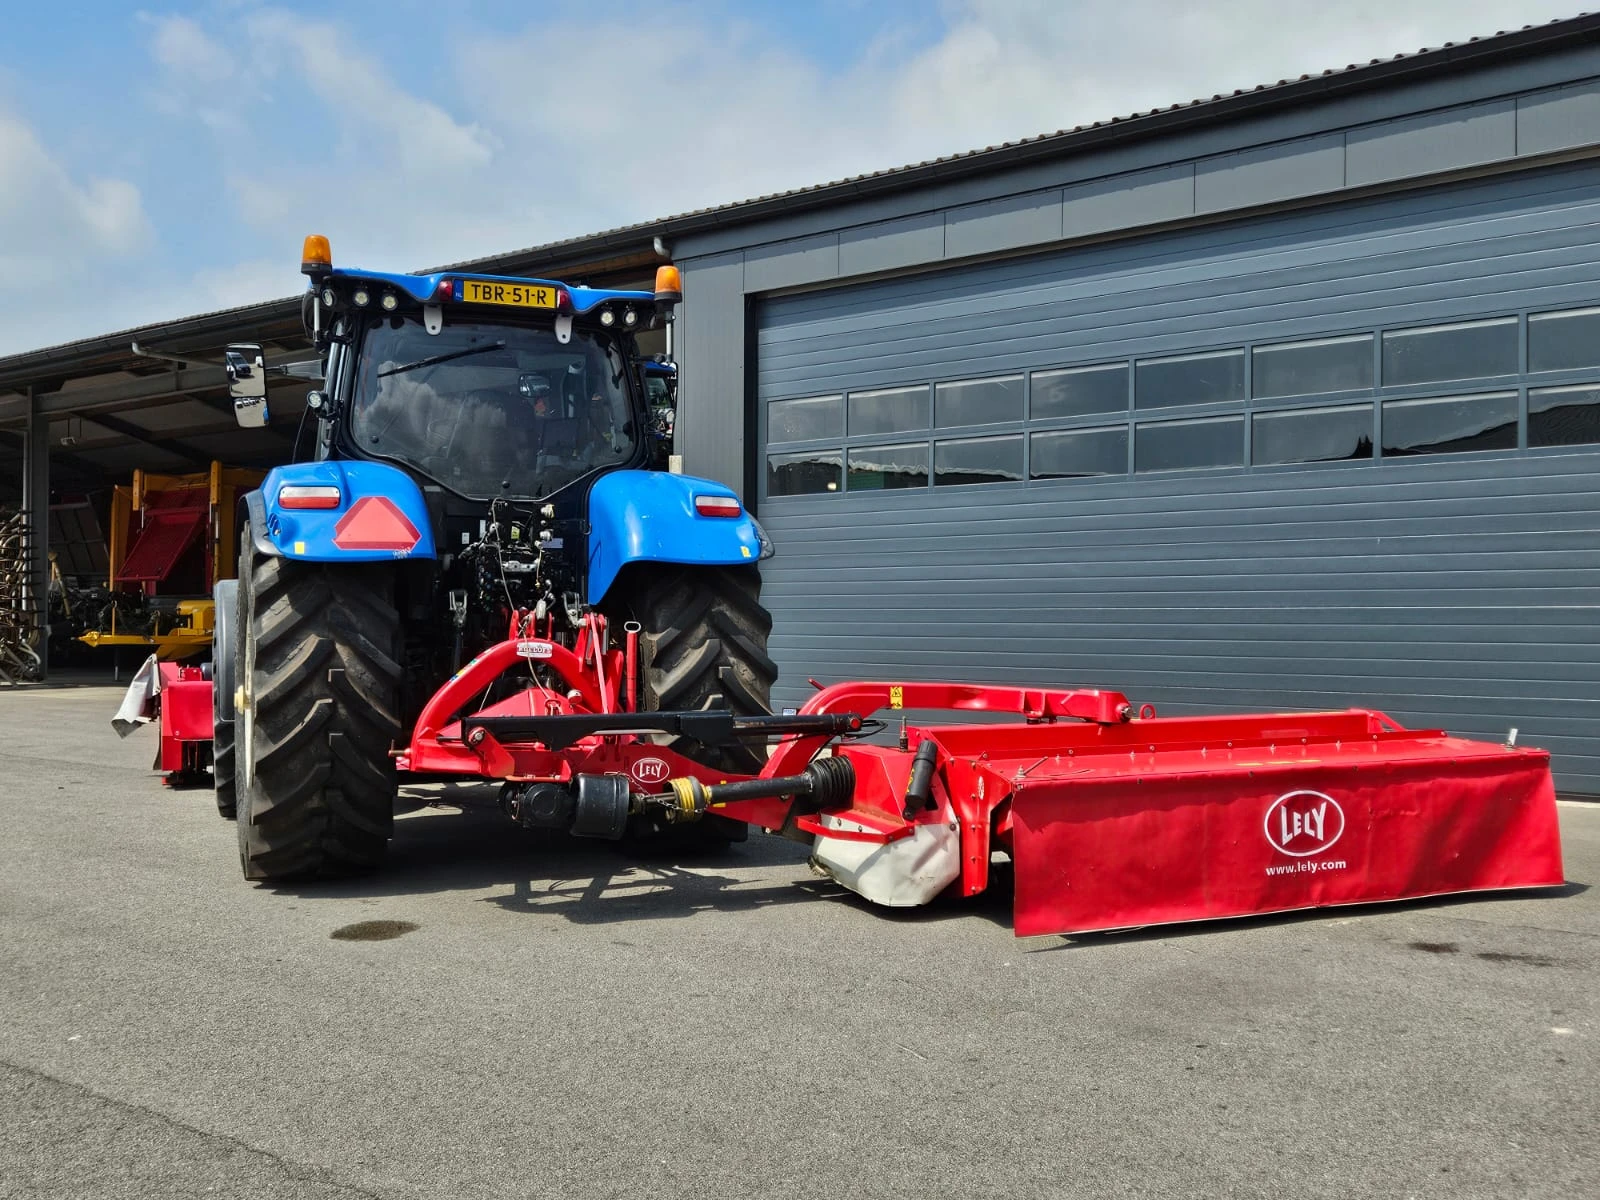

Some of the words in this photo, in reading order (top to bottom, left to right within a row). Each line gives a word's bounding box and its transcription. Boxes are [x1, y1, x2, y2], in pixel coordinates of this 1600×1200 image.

[471, 284, 547, 305] TBR-51-R
[640, 761, 662, 778] LELY
[1281, 801, 1327, 846] LELY
[1265, 860, 1347, 876] www.lely.com
